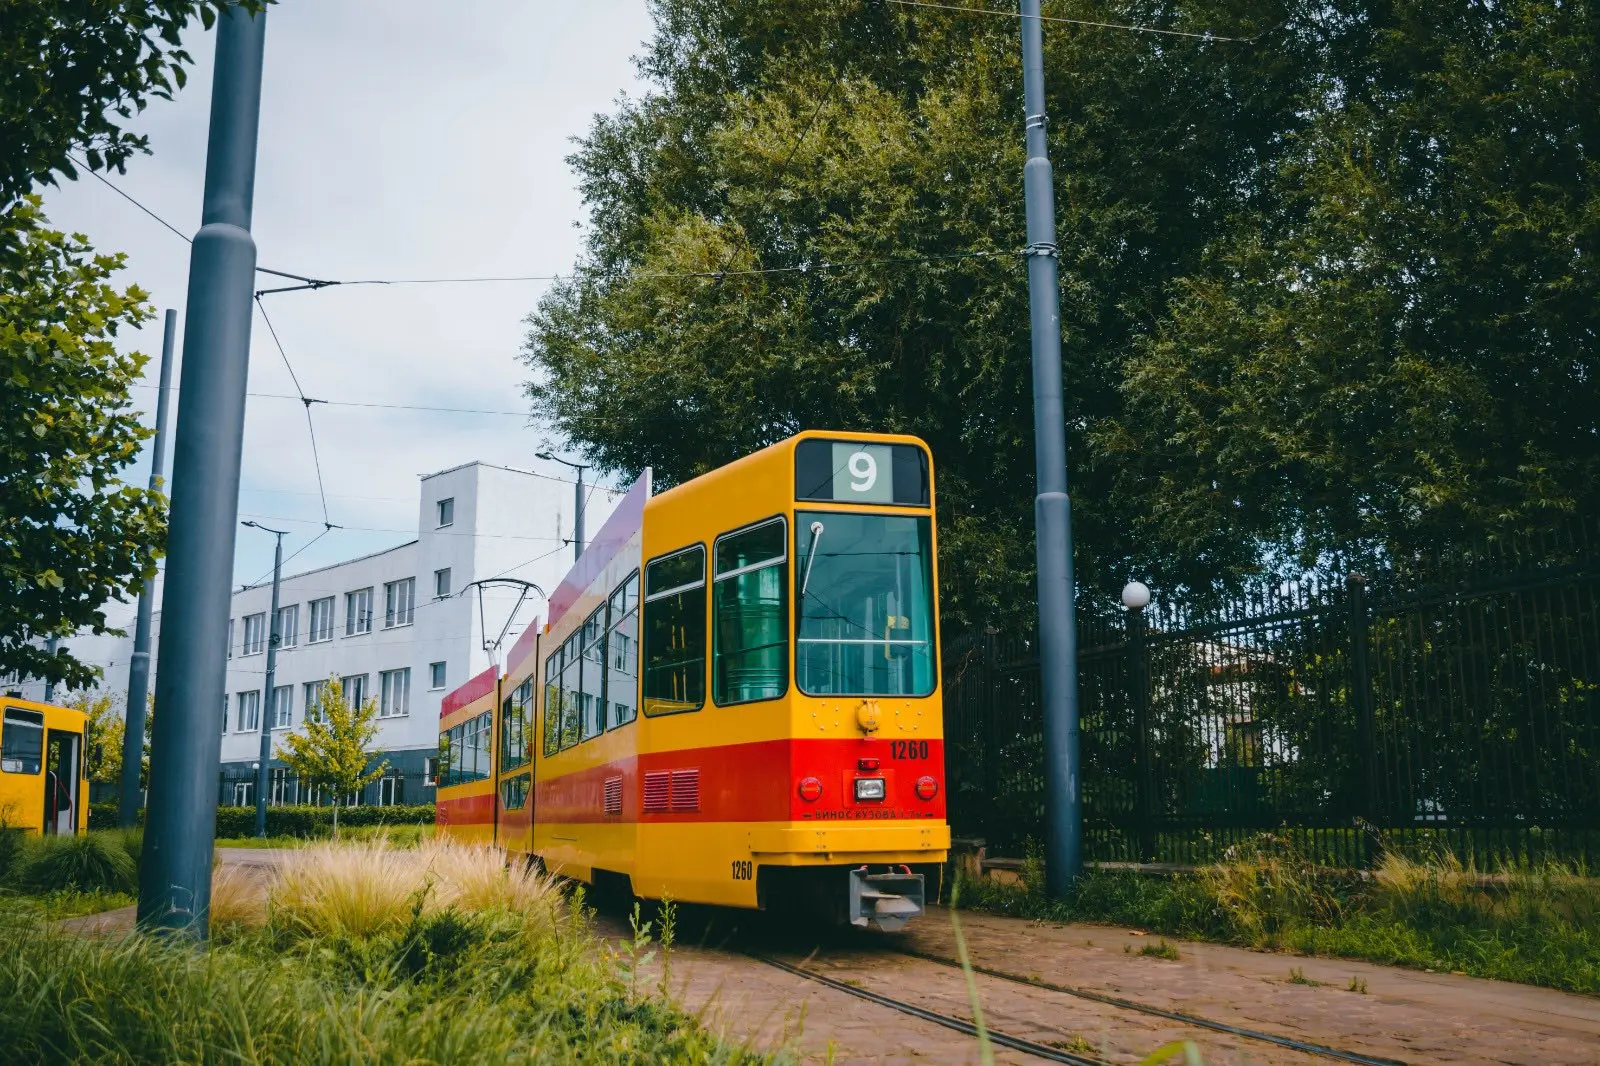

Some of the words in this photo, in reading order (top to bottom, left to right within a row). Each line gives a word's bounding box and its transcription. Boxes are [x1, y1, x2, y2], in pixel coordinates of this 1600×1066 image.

[848, 451, 877, 492] 9
[891, 740, 928, 760] 1260
[815, 810, 852, 820] ВИНОС
[855, 809, 897, 819] КУЗОВА
[731, 860, 753, 881] 1260
